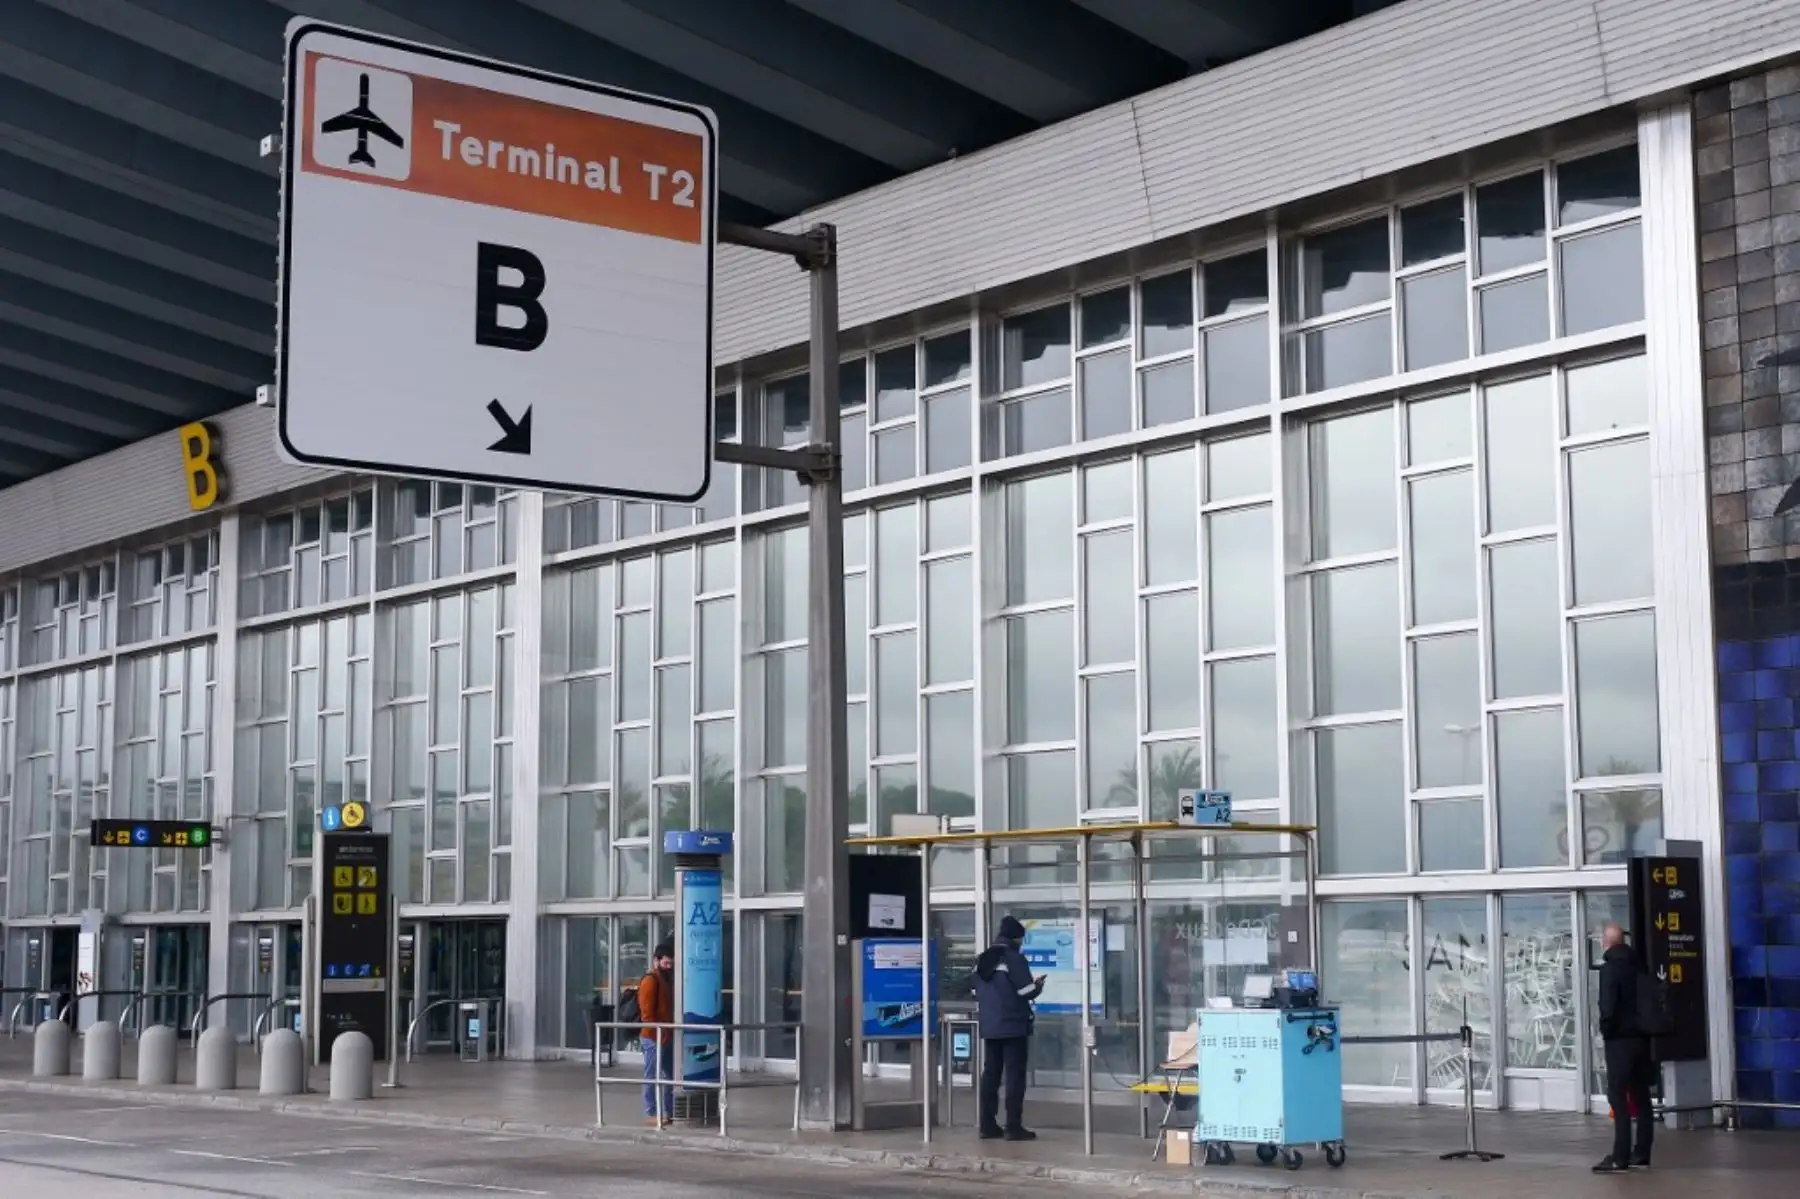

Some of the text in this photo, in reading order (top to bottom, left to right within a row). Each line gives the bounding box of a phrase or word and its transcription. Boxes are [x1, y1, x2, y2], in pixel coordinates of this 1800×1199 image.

[433, 119, 695, 208] Terminal T2
[475, 240, 549, 352] B
[178, 422, 219, 511] B
[1214, 807, 1231, 823] A2
[135, 829, 146, 841] C
[193, 830, 203, 843] B
[687, 901, 720, 926] A2
